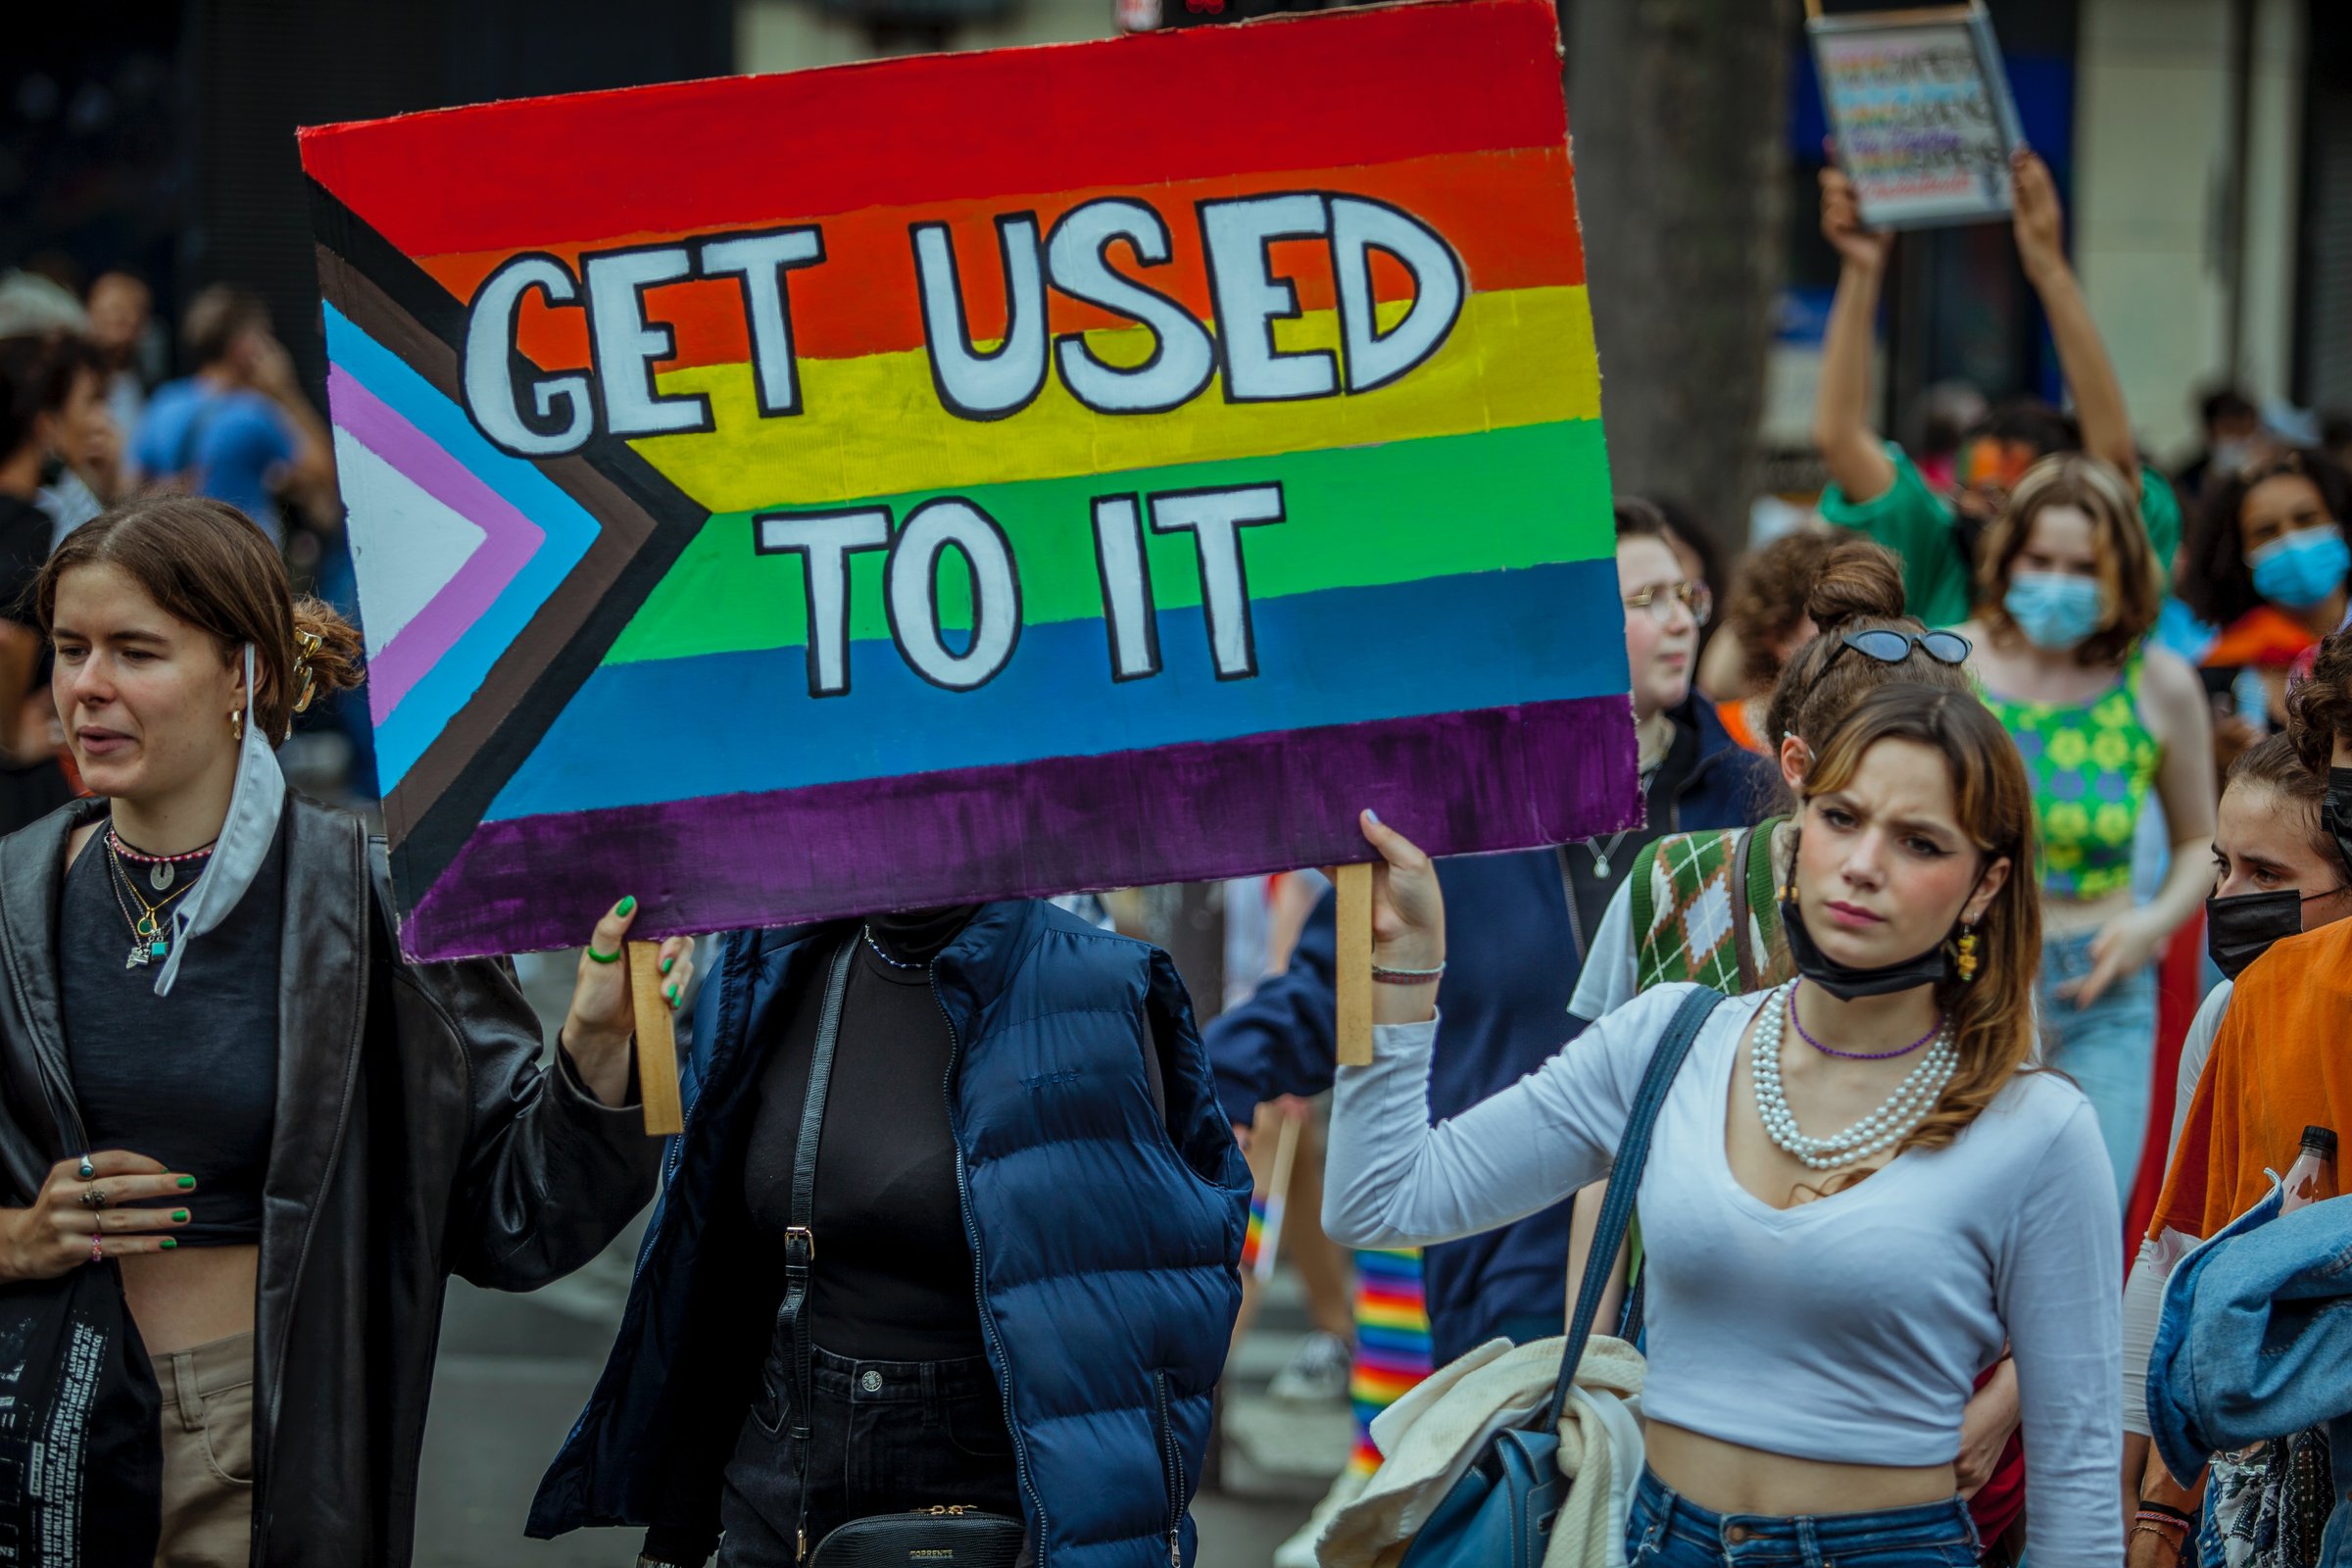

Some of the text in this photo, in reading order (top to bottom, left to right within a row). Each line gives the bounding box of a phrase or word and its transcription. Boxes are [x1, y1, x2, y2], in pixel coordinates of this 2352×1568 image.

[457, 189, 1469, 461] GET USED
[753, 480, 1286, 698] TO IT
